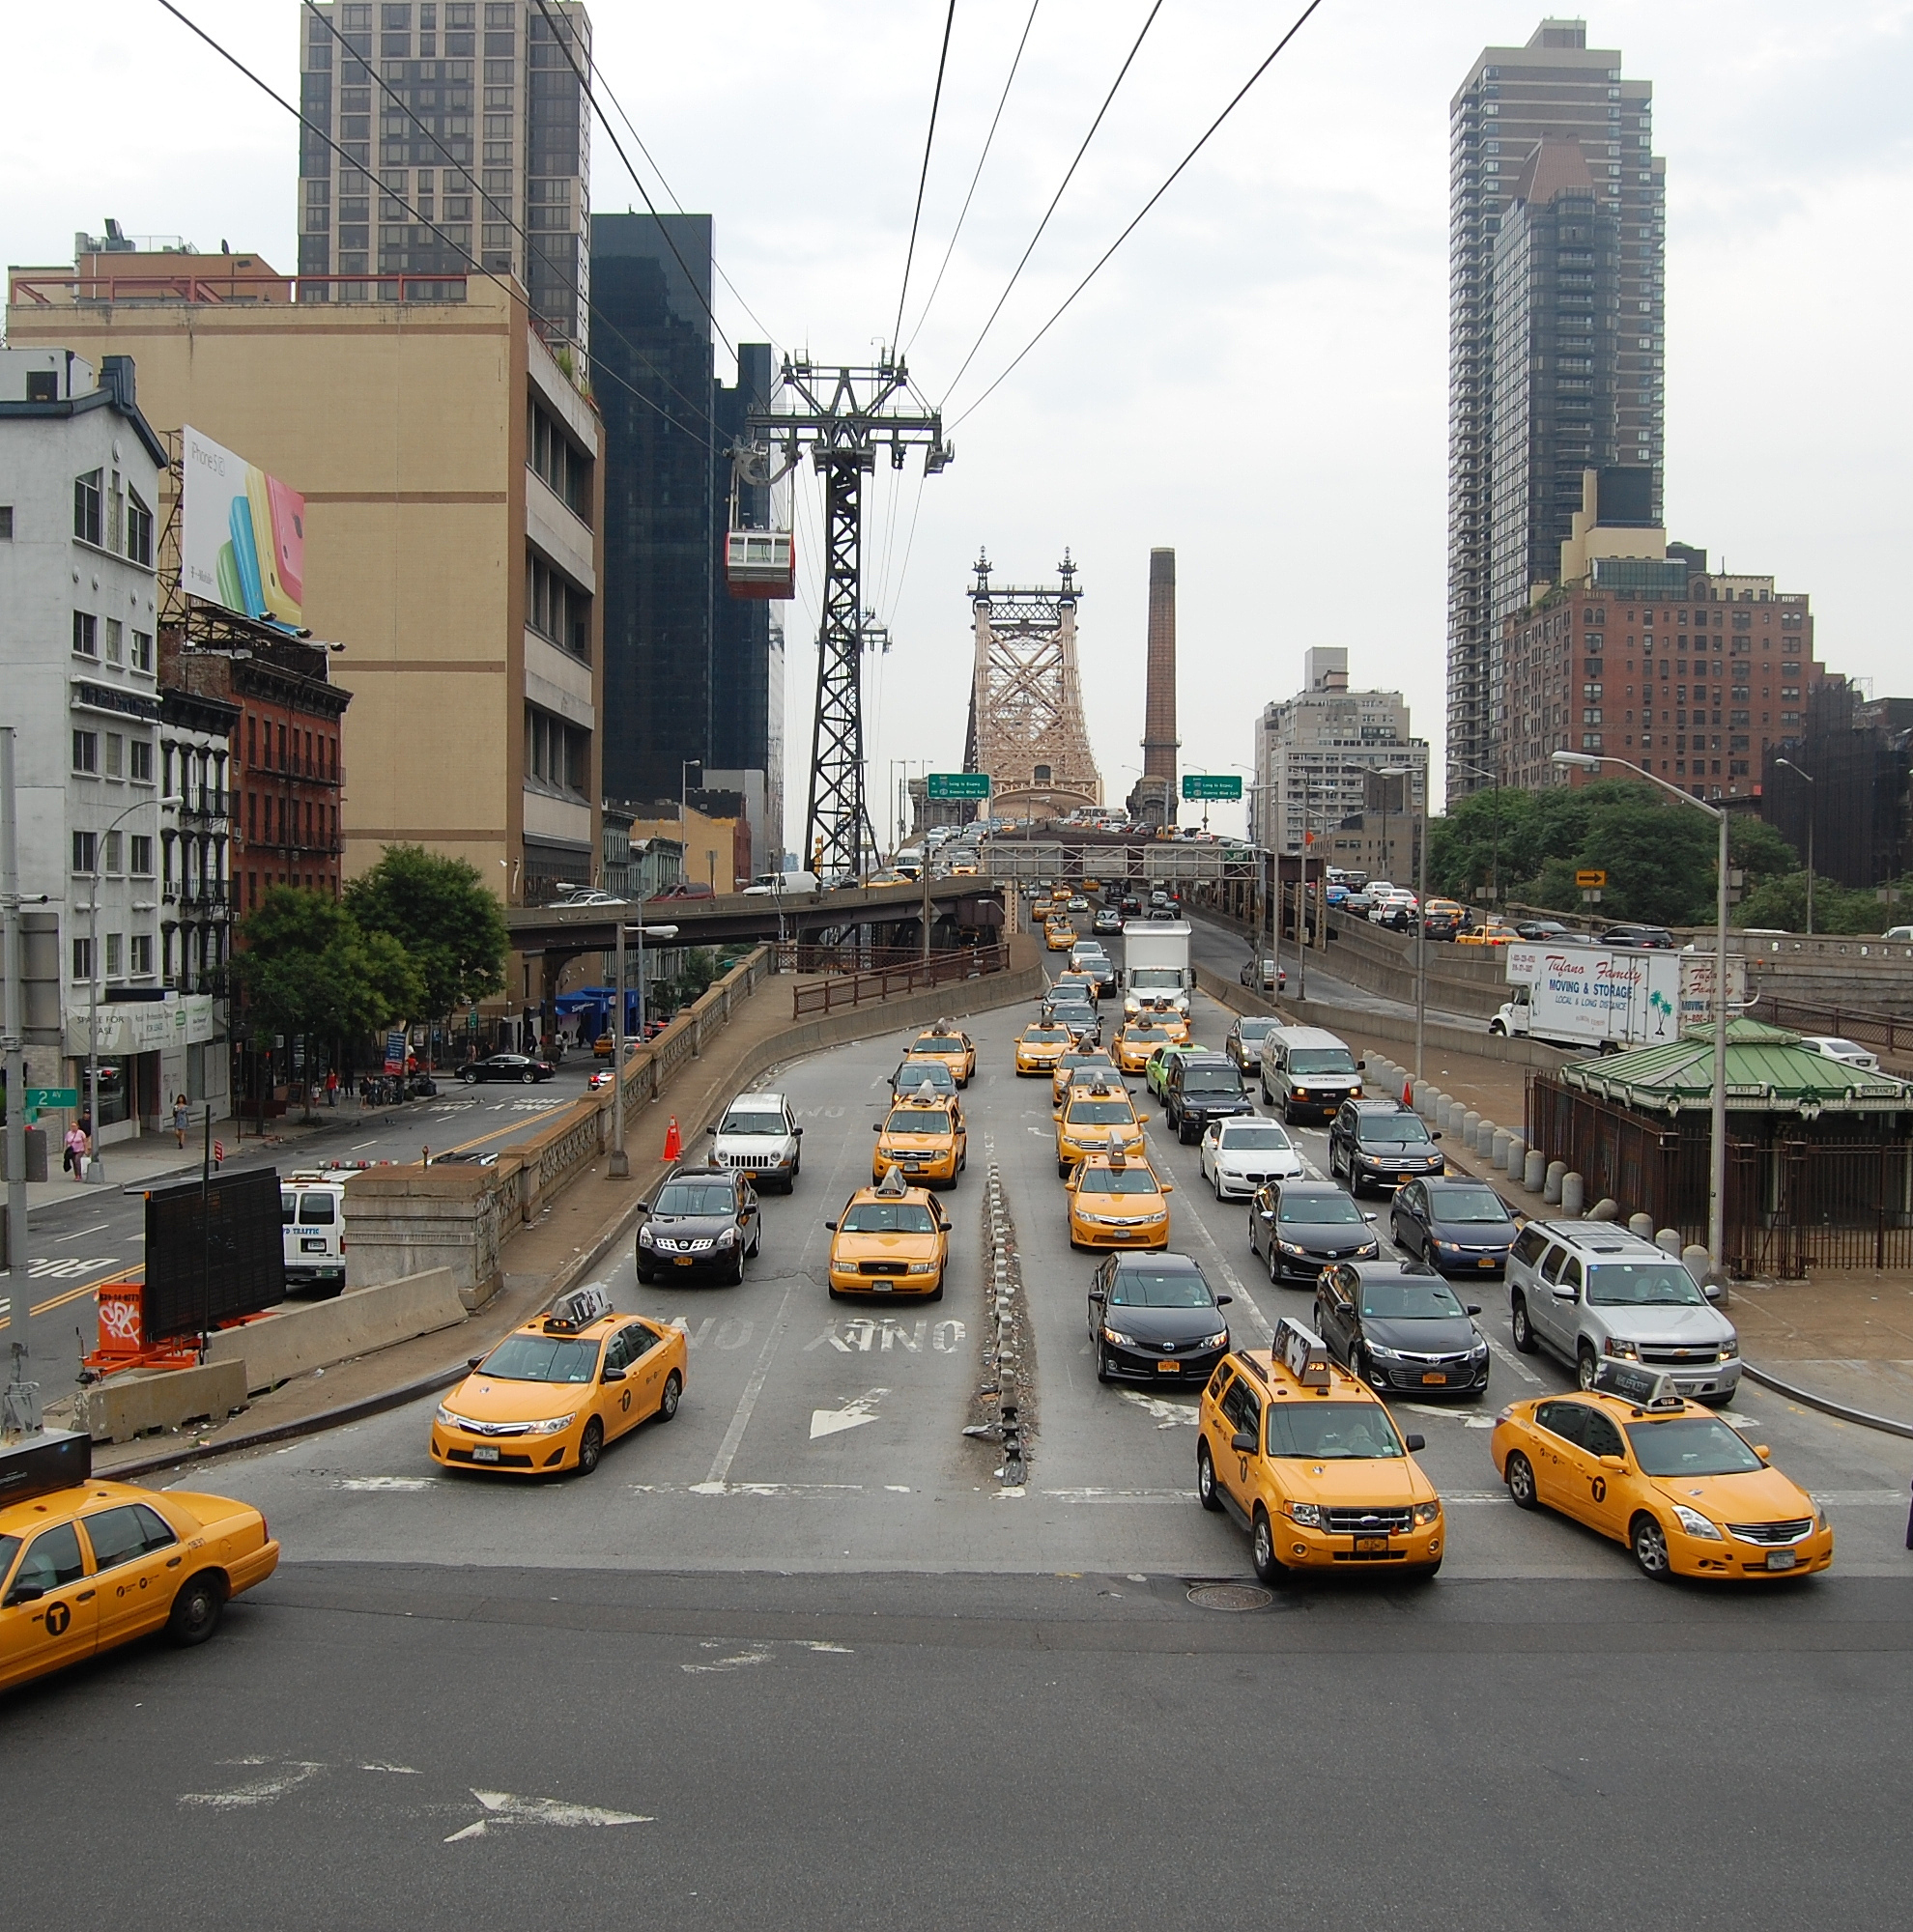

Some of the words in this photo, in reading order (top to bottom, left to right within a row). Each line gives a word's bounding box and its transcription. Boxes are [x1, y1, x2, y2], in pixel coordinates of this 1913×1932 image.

[1545, 954, 1585, 977] Tufano
[1595, 961, 1642, 984] Family
[1549, 979, 1580, 993] MOVING
[1583, 982, 1589, 994] &
[1593, 983, 1633, 999] STORAGE
[76, 1015, 102, 1024] SPAE
[106, 1015, 125, 1024] FOR
[88, 1027, 113, 1036] LASE
[1734, 1085, 1753, 1094] EXIT
[1862, 1086, 1895, 1094] ENTRANCE
[39, 1091, 48, 1106] 2
